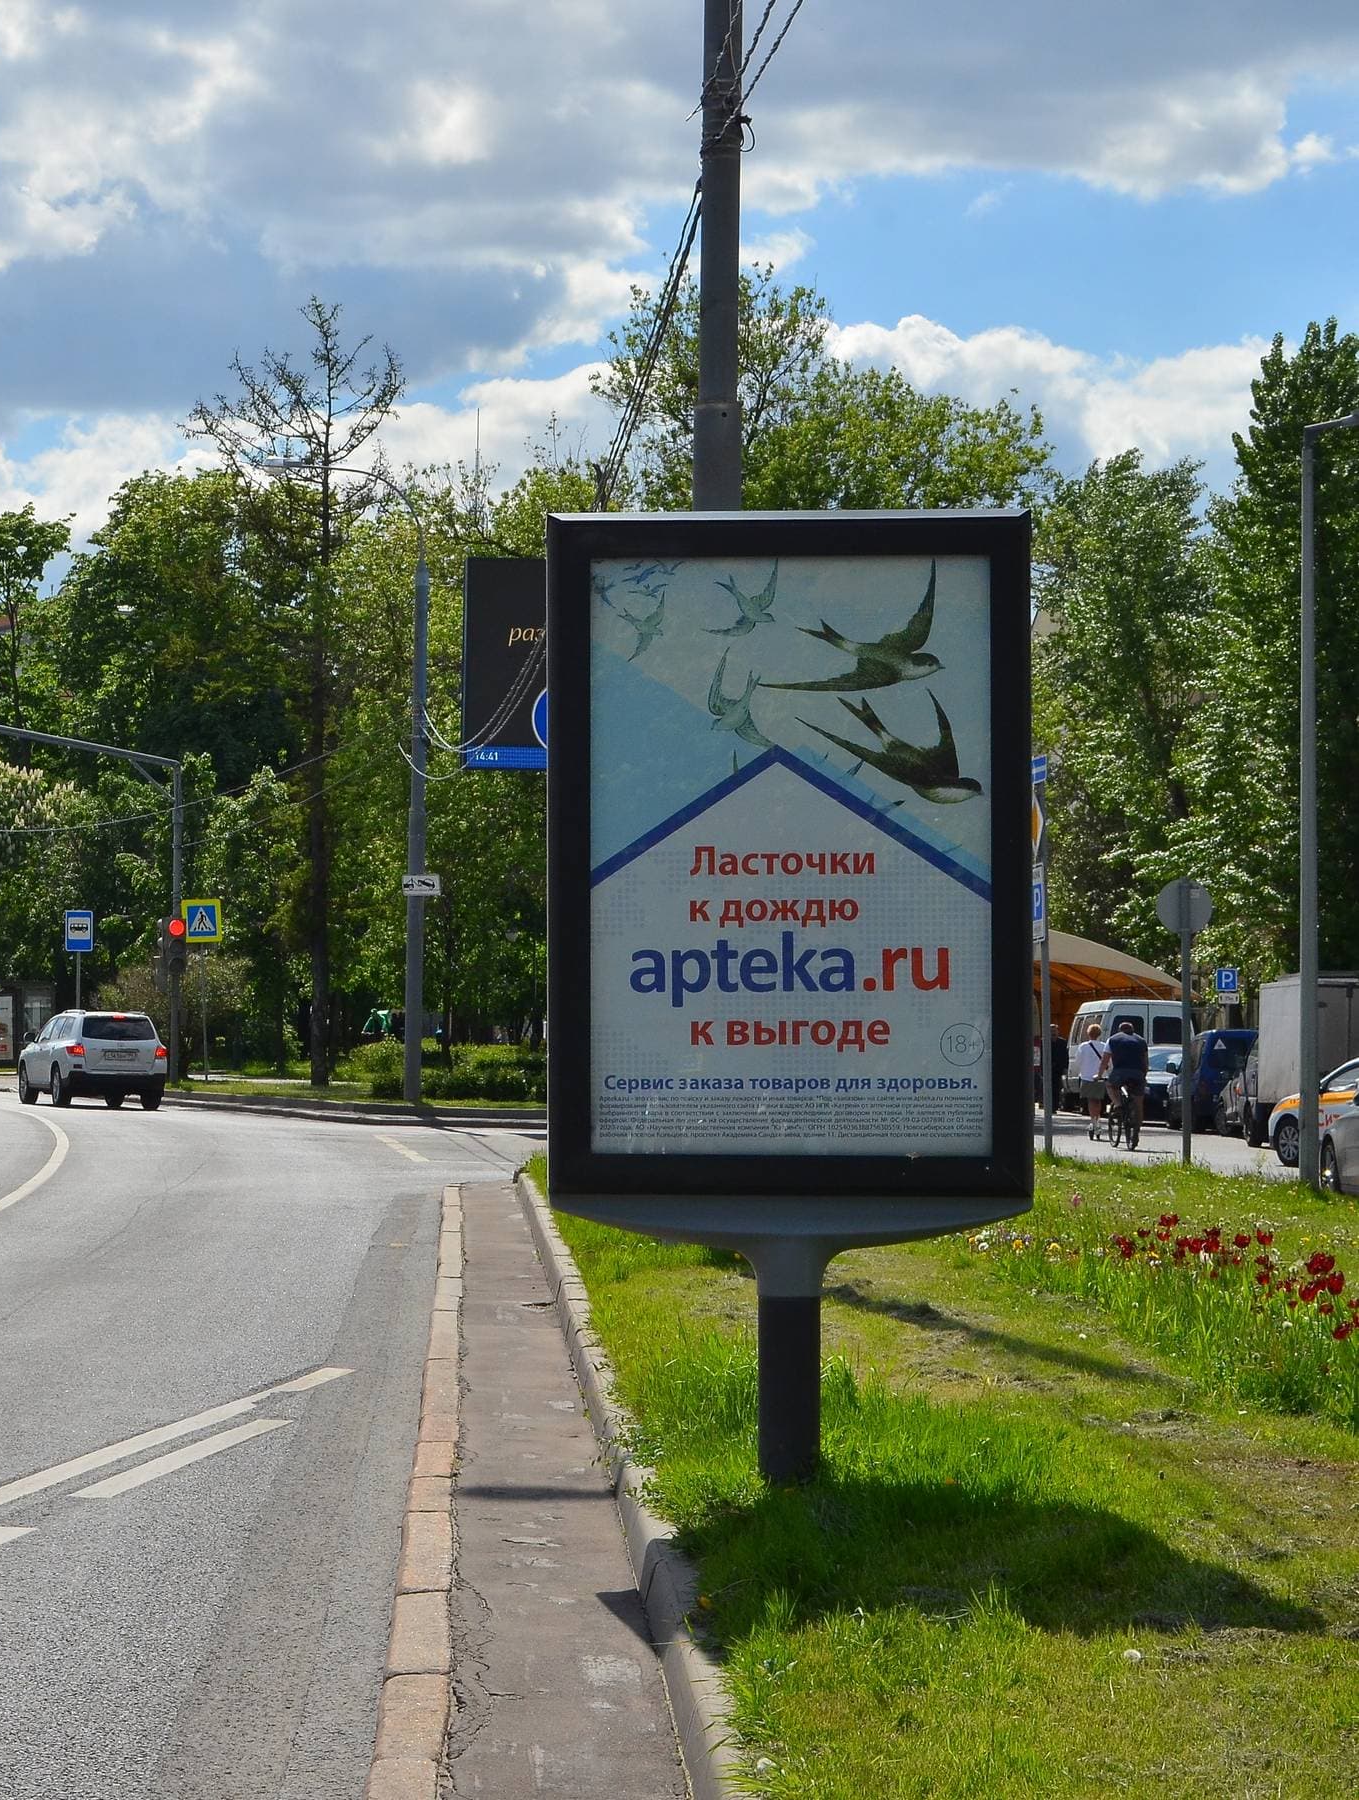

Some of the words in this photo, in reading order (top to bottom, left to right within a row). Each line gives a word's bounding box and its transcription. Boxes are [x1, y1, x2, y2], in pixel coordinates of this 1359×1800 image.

[475, 751, 498, 760] 14:41
[690, 846, 876, 875] Ласточки
[689, 900, 711, 922] к
[719, 899, 860, 927] дождю
[629, 931, 951, 1008] apteka.ru
[692, 1022, 713, 1045] к
[727, 1020, 891, 1053] выгоде
[947, 1035, 979, 1053] 18+
[604, 1074, 674, 1093] Сервис
[678, 1078, 744, 1090] заказа
[749, 1078, 831, 1093] товаров
[835, 1078, 872, 1093] для
[876, 1078, 978, 1093] здоровья.
